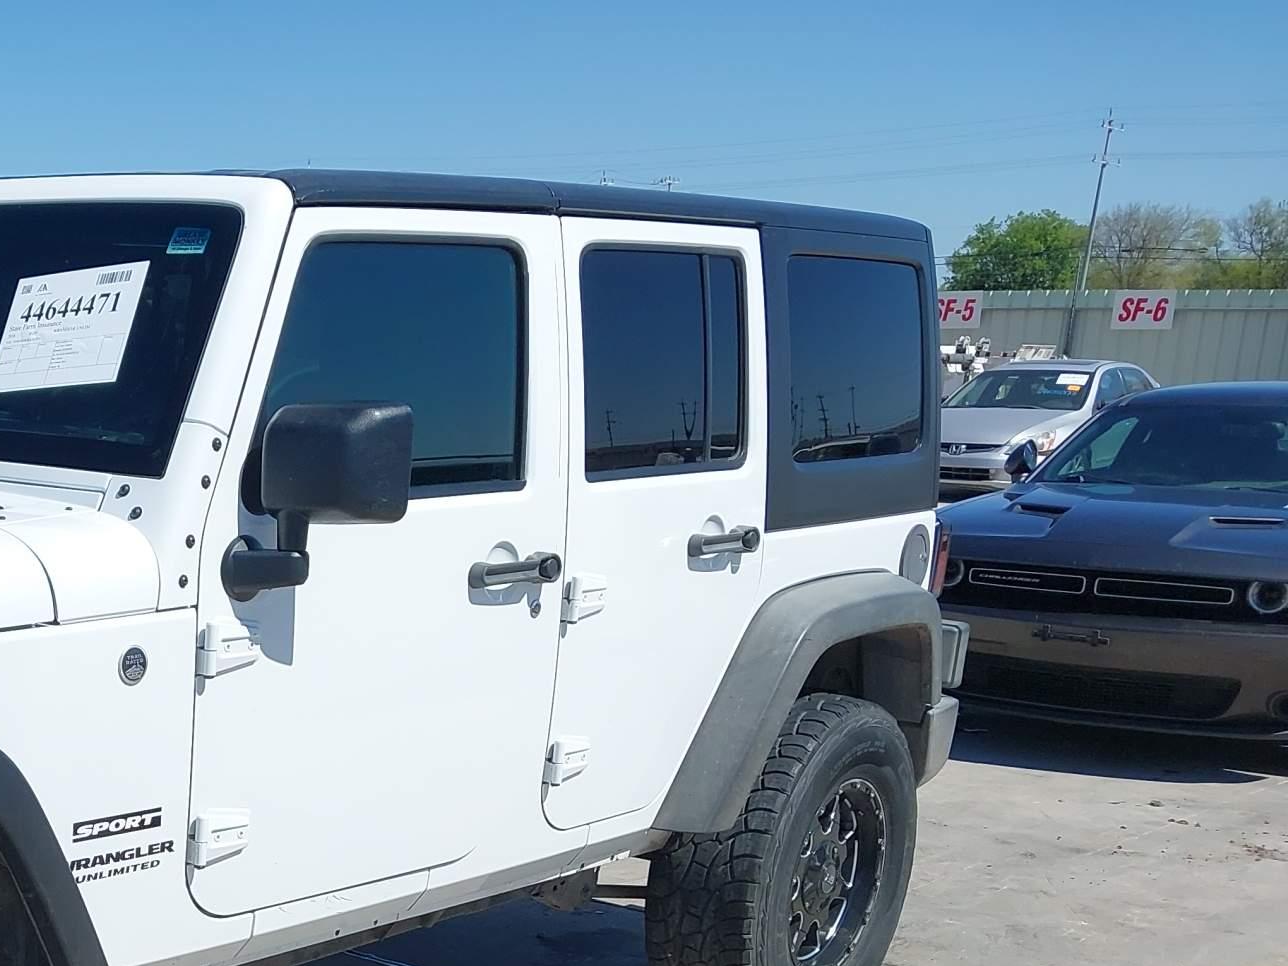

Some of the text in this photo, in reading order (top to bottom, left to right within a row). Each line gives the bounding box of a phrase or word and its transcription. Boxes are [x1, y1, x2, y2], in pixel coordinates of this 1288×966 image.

[21, 291, 122, 323] 44644471
[1118, 297, 1169, 322] SF-6
[76, 814, 158, 838] SPORT
[76, 859, 161, 885] UNLIMITED
